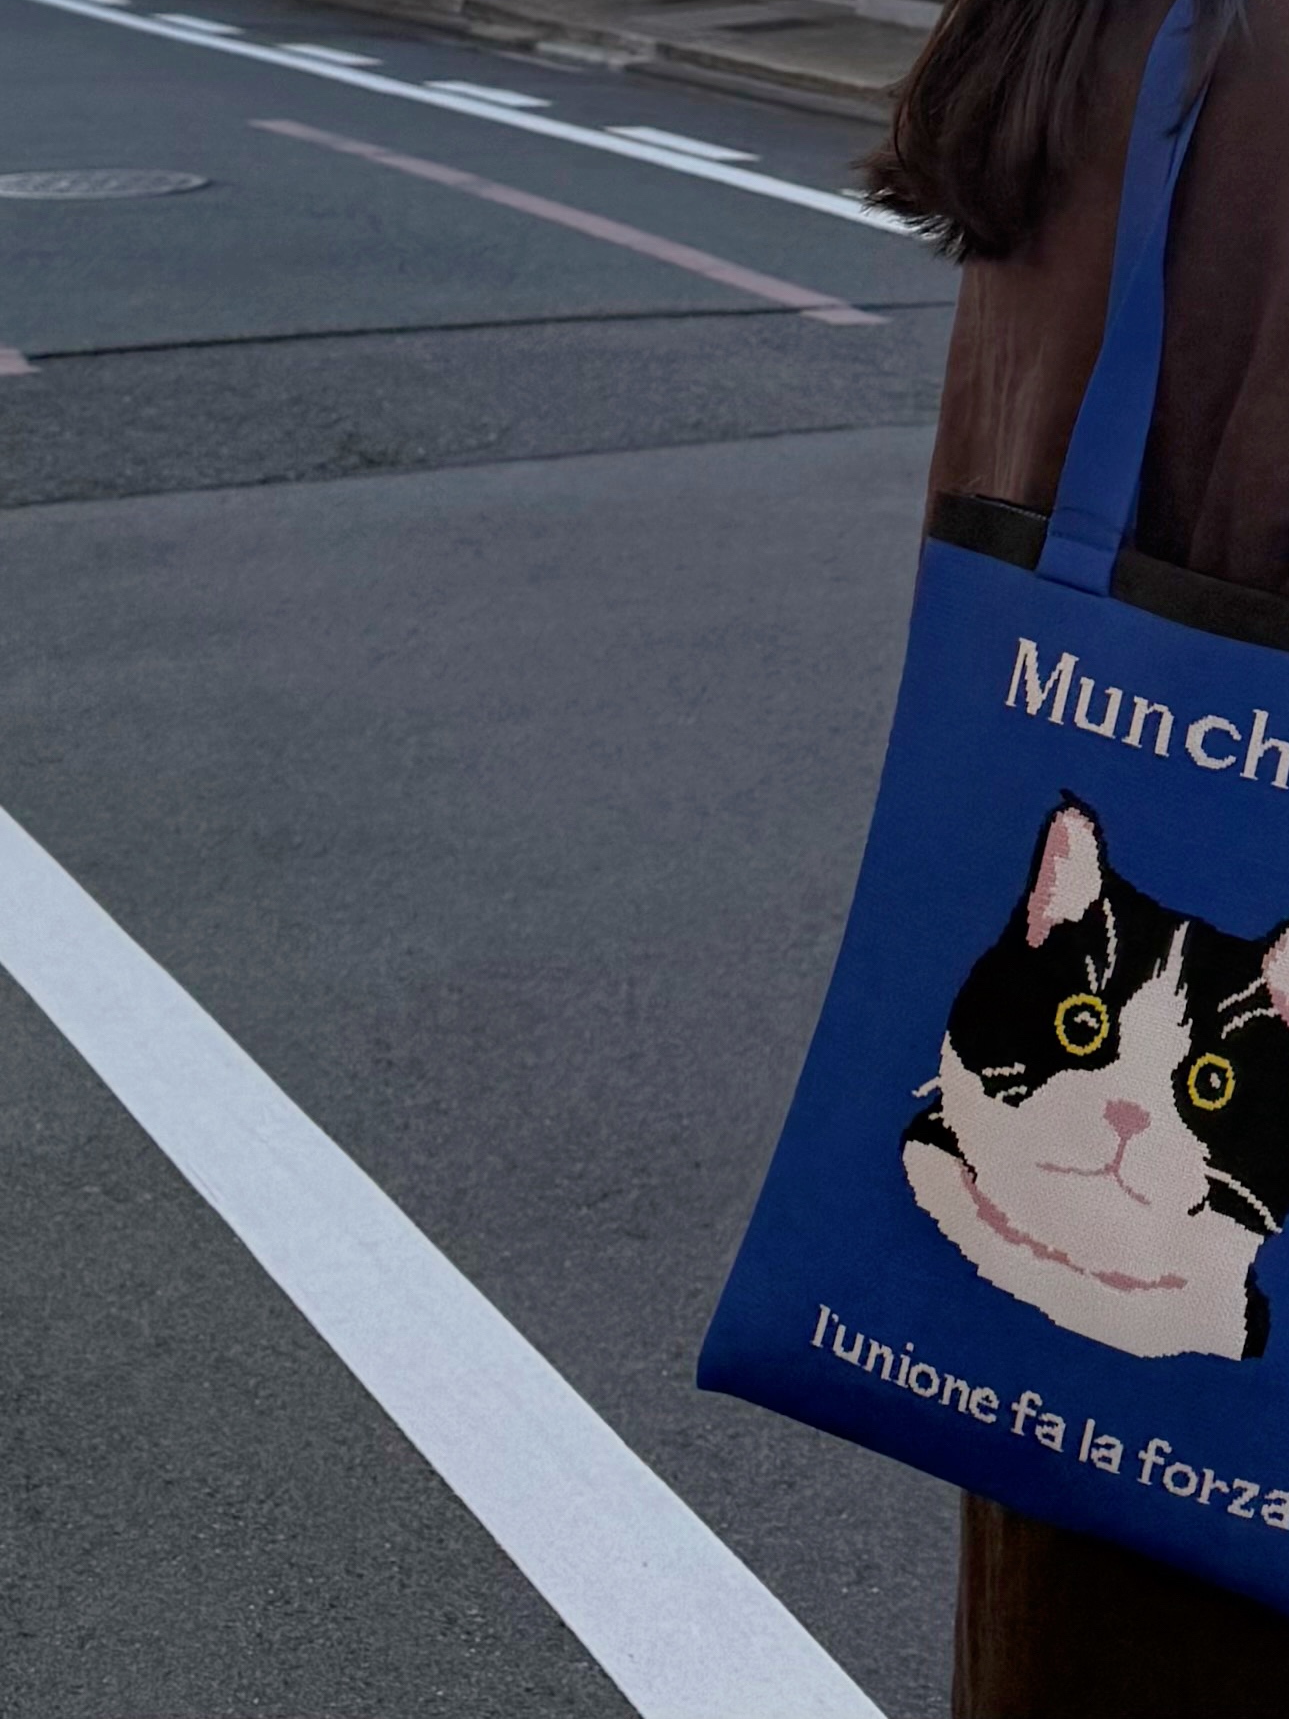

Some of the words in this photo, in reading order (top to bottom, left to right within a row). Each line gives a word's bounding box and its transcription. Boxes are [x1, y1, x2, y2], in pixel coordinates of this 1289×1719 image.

[810, 1303, 1000, 1424] l'unione
[1011, 1390, 1066, 1452] fa
[1079, 1418, 1125, 1474] la
